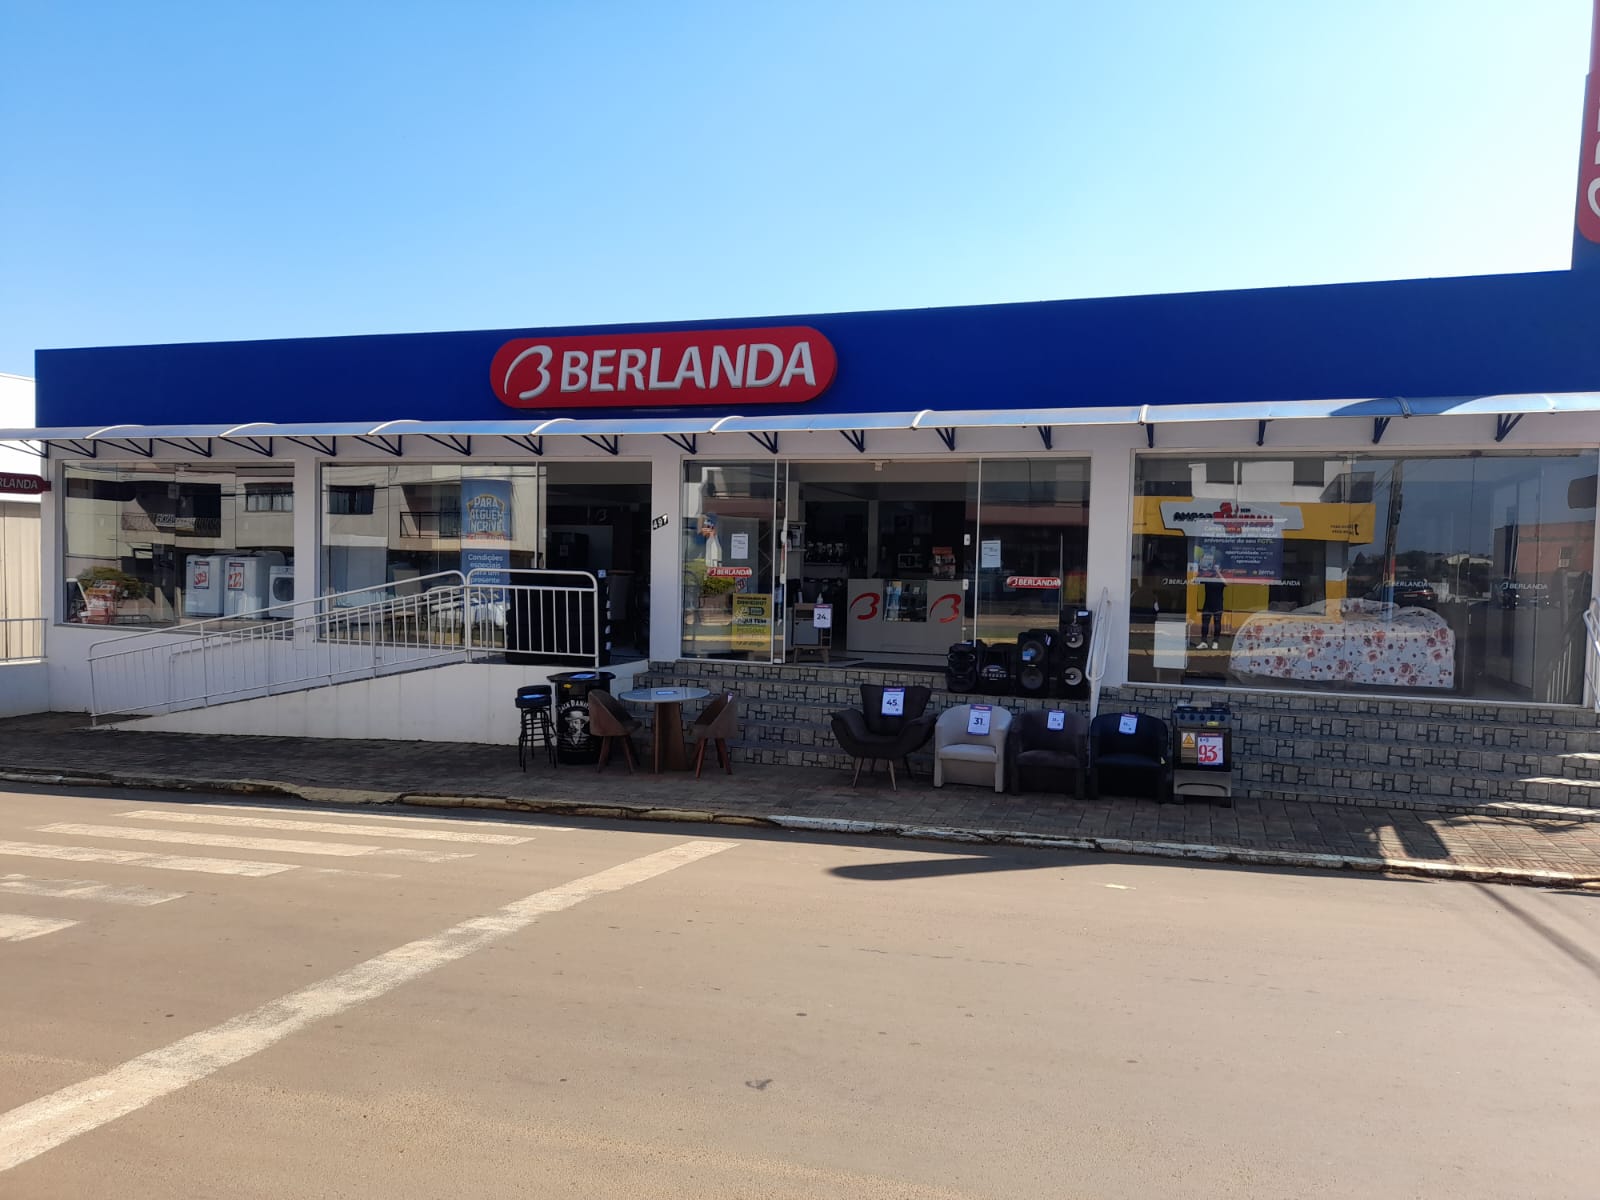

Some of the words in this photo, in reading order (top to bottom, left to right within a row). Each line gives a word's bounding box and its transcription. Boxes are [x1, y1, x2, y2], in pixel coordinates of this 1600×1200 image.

[560, 341, 817, 393] BERLANDA
[474, 496, 499, 508] PARA
[467, 553, 504, 562] Condições
[1018, 578, 1060, 587] BERLANDA
[1198, 744, 1218, 763] 93
